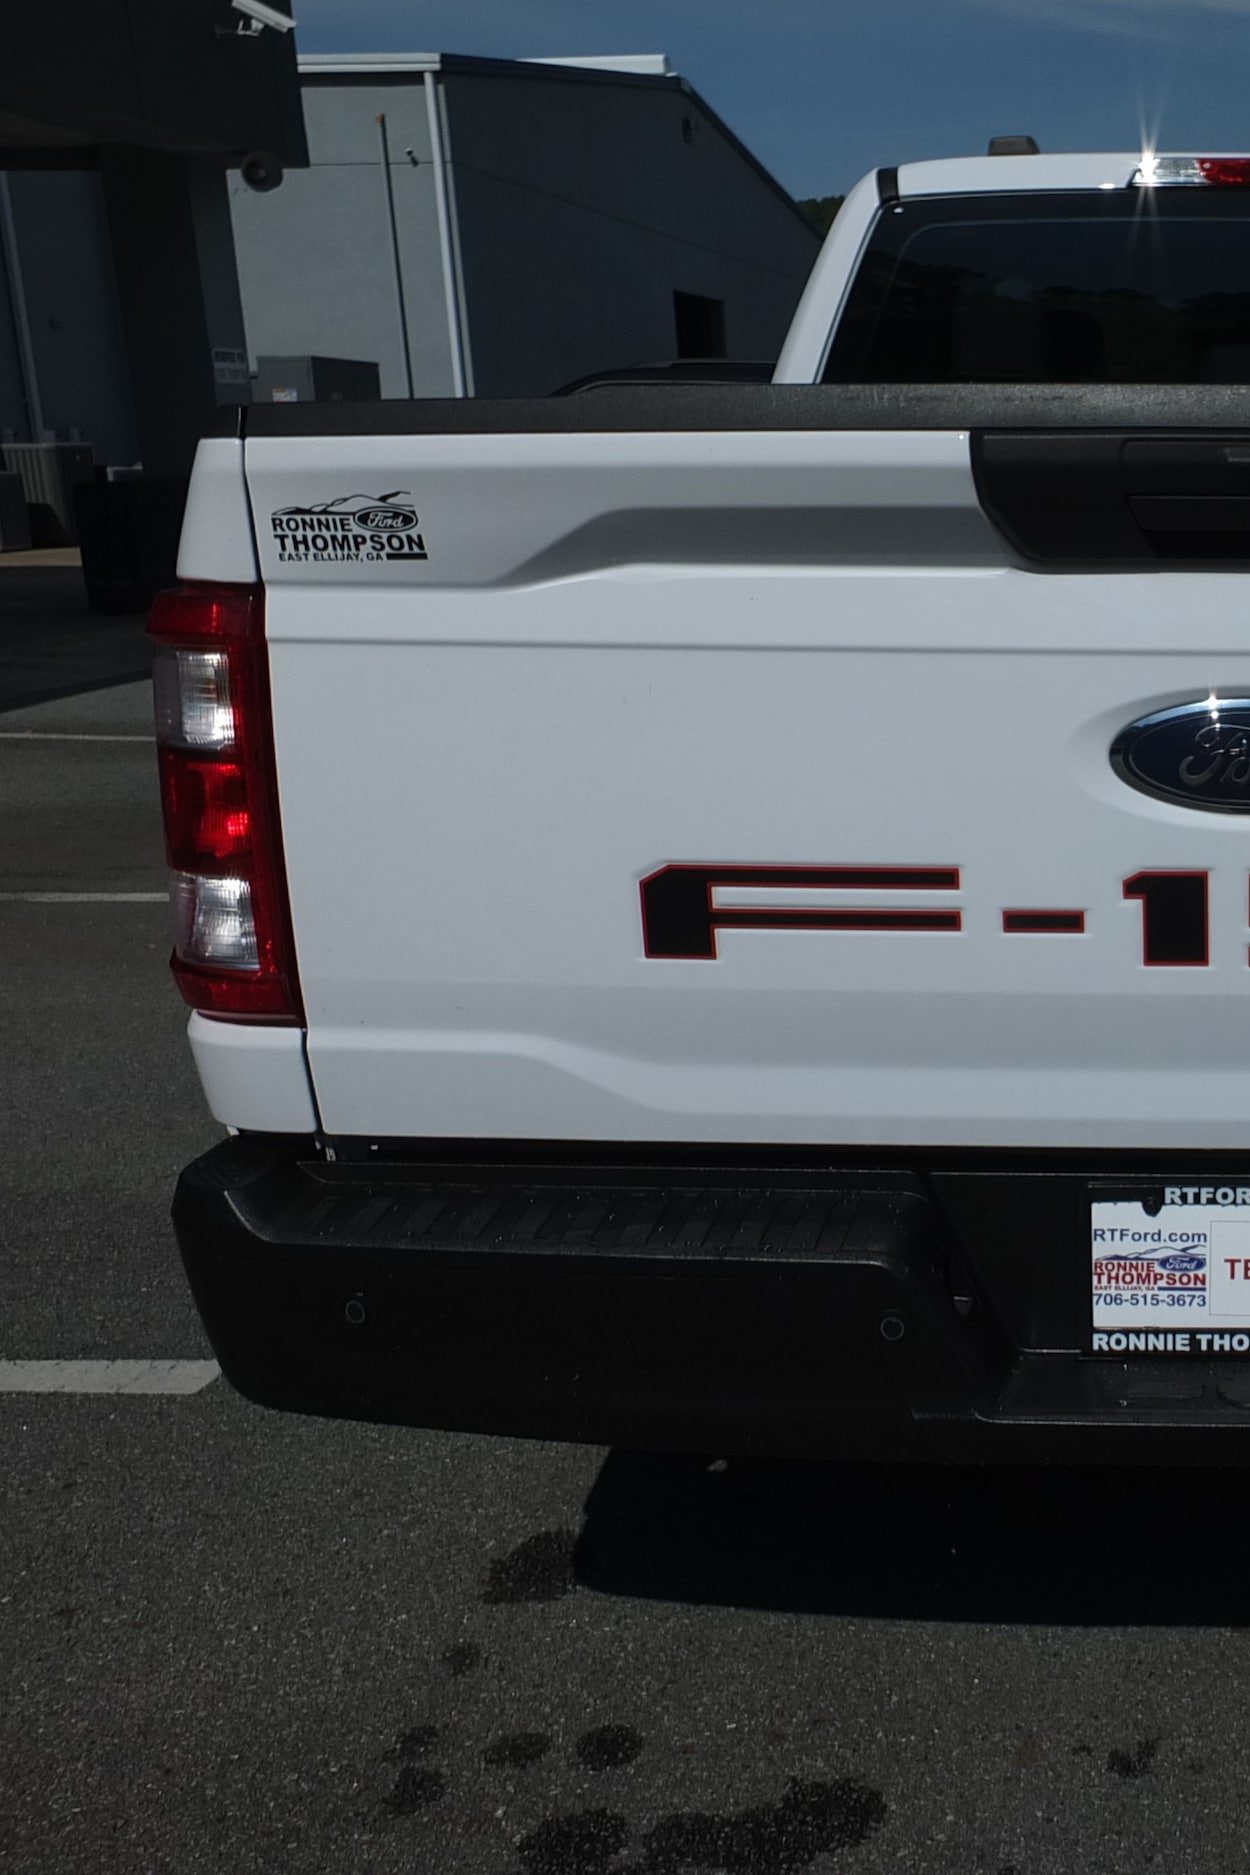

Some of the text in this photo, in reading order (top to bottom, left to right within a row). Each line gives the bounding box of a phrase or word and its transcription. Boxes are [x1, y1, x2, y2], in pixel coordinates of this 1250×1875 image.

[271, 517, 353, 532] RONNIE
[367, 511, 404, 528] Ford
[273, 534, 426, 552] THOMPSON
[279, 552, 384, 563] EAST ELLIJAY, GA
[1093, 1228, 1207, 1243] RTFord.com
[1094, 1261, 1155, 1272] RONNIE
[1165, 1256, 1197, 1270] Ford
[1094, 1272, 1206, 1286] THOMPSON
[1093, 1293, 1206, 1307] 706-515-3673
[1092, 1333, 1190, 1351] RONNIE
